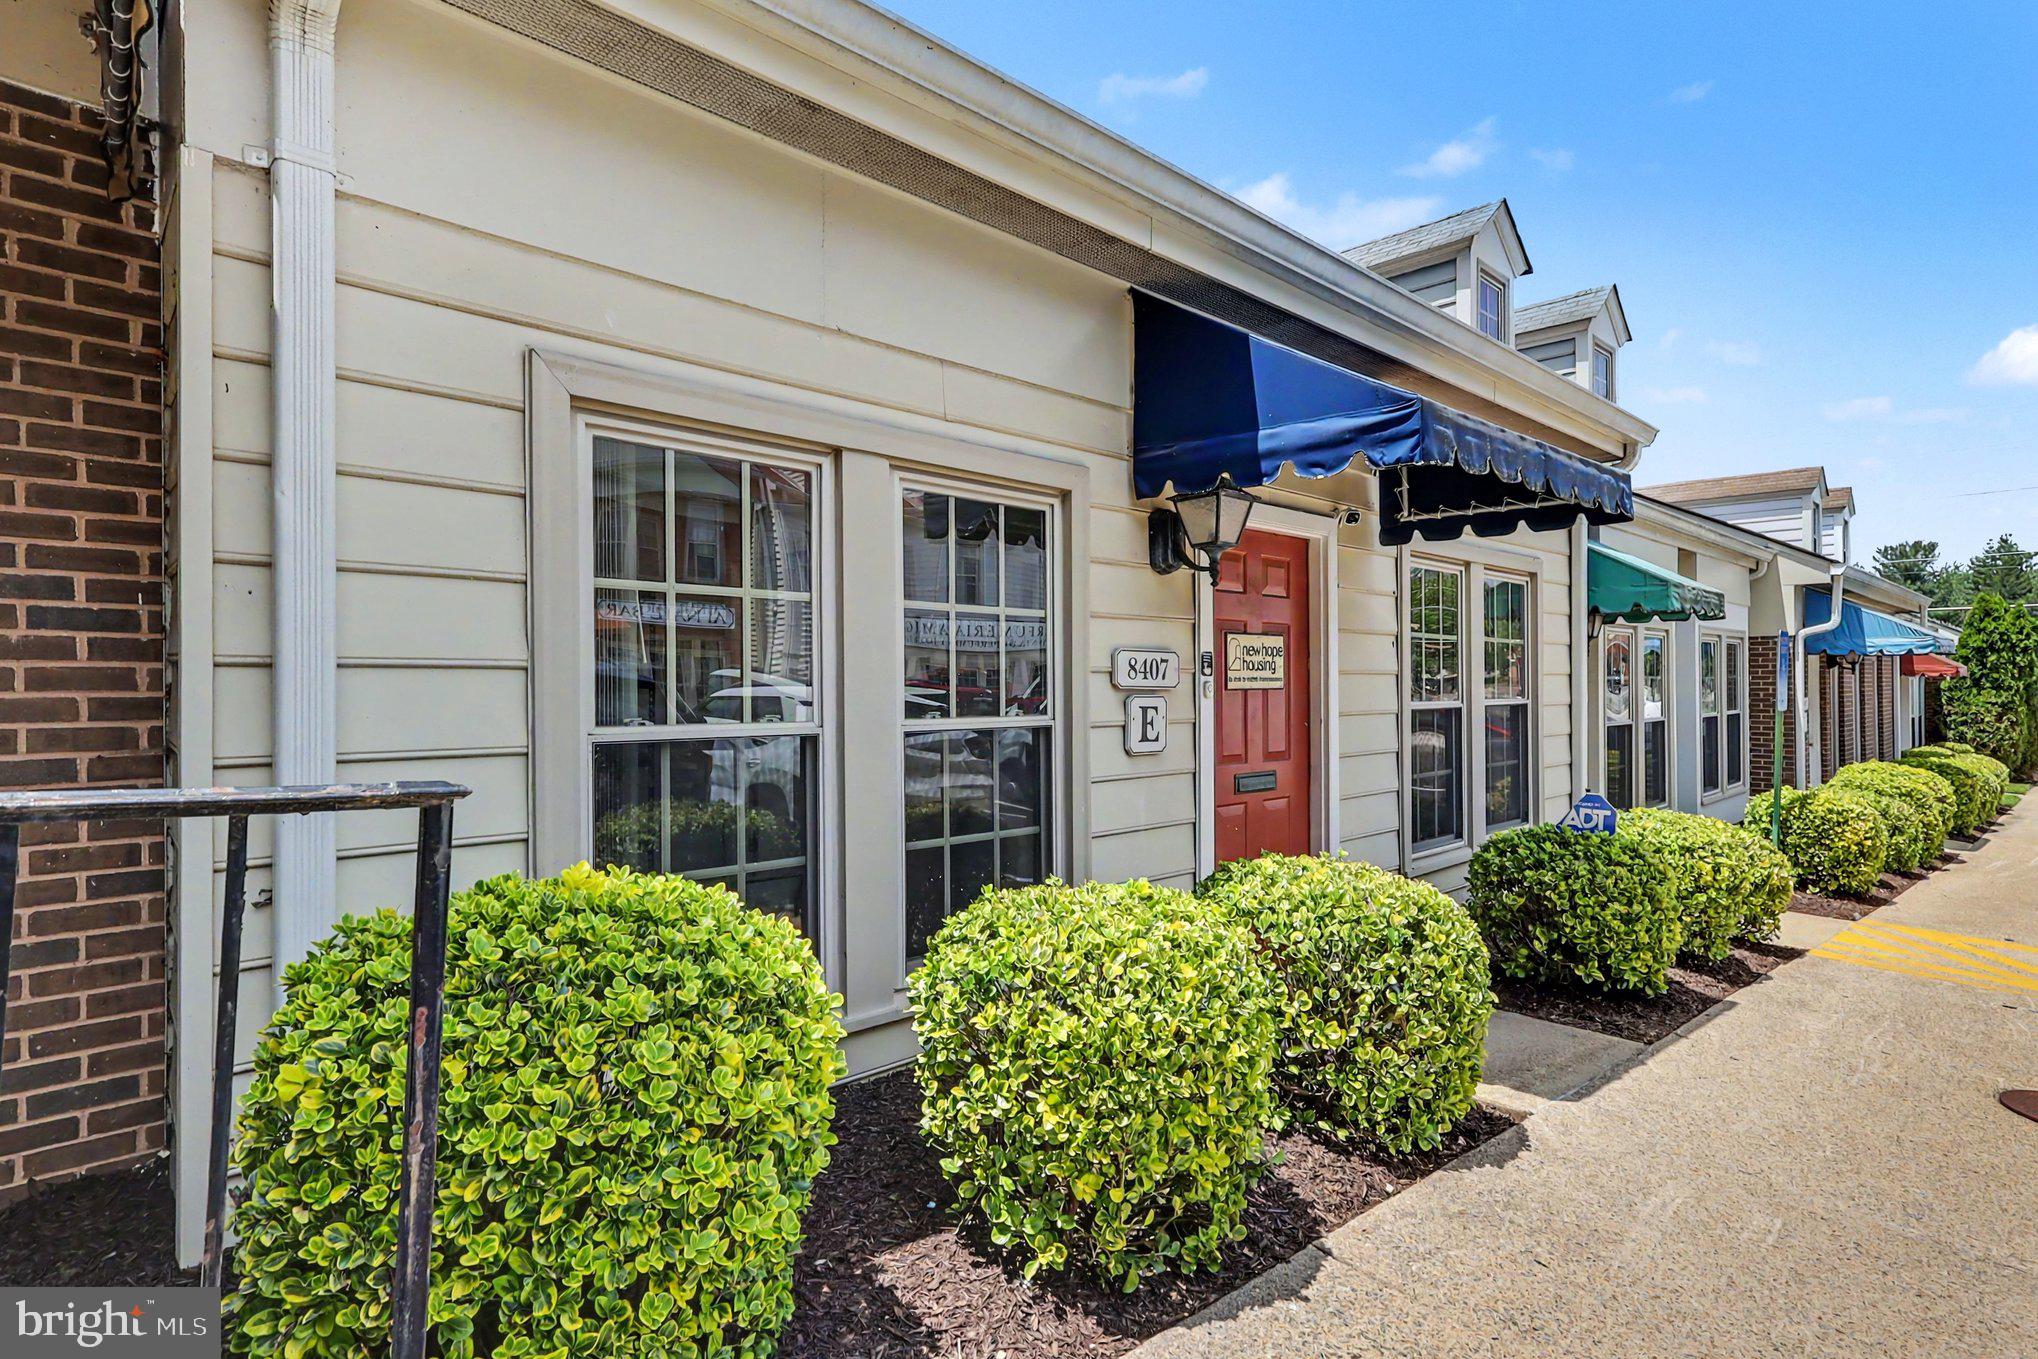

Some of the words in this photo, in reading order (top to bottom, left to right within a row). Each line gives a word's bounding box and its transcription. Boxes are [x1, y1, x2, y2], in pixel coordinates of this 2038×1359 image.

[1128, 657, 1169, 680] 8407
[1242, 657, 1276, 674] housing
[1138, 706, 1160, 743] E
[1561, 807, 1612, 830] ADT
